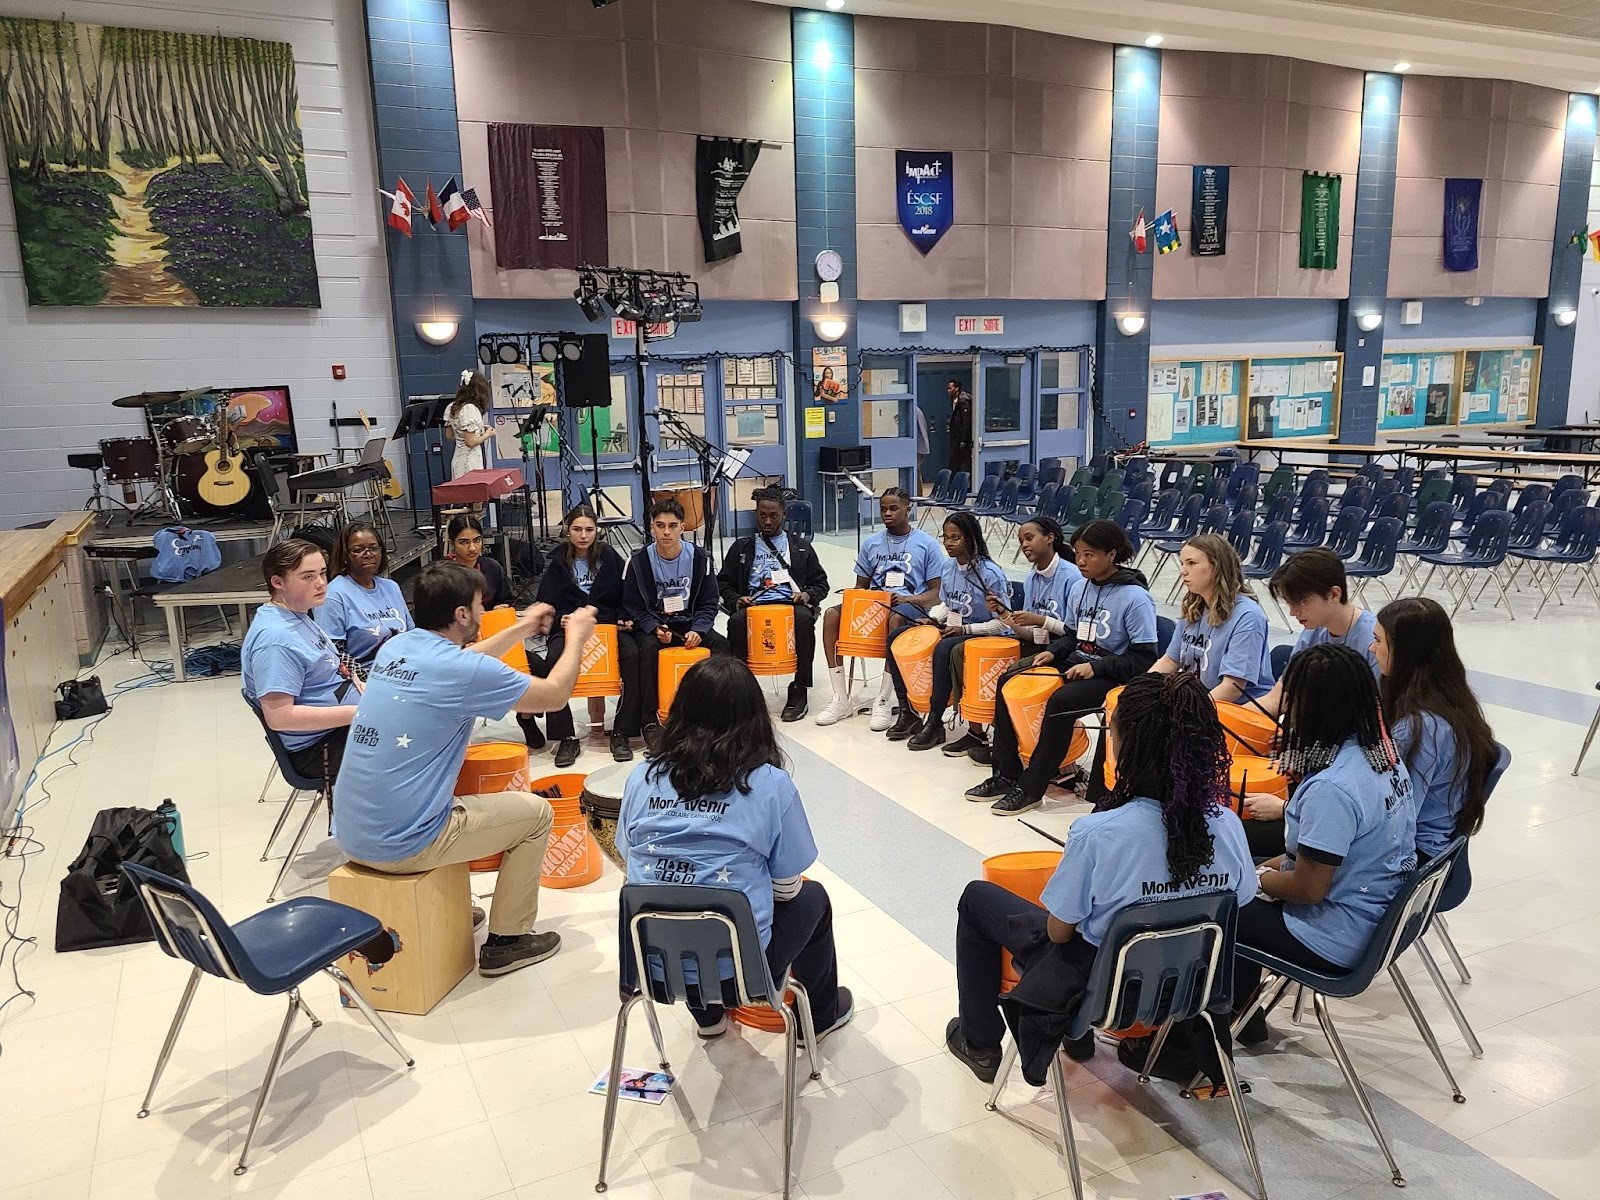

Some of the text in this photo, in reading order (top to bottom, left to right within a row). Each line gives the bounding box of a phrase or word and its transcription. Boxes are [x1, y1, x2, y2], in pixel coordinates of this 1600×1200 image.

[907, 190, 943, 205] ÉSCSF
[914, 206, 933, 215] 2018
[616, 319, 636, 335] EXI
[959, 318, 976, 331] EXIT
[851, 601, 882, 632] DEPOT
[858, 608, 887, 638] HOME
[543, 826, 587, 876] HOME
[556, 843, 588, 877] DEPOT
